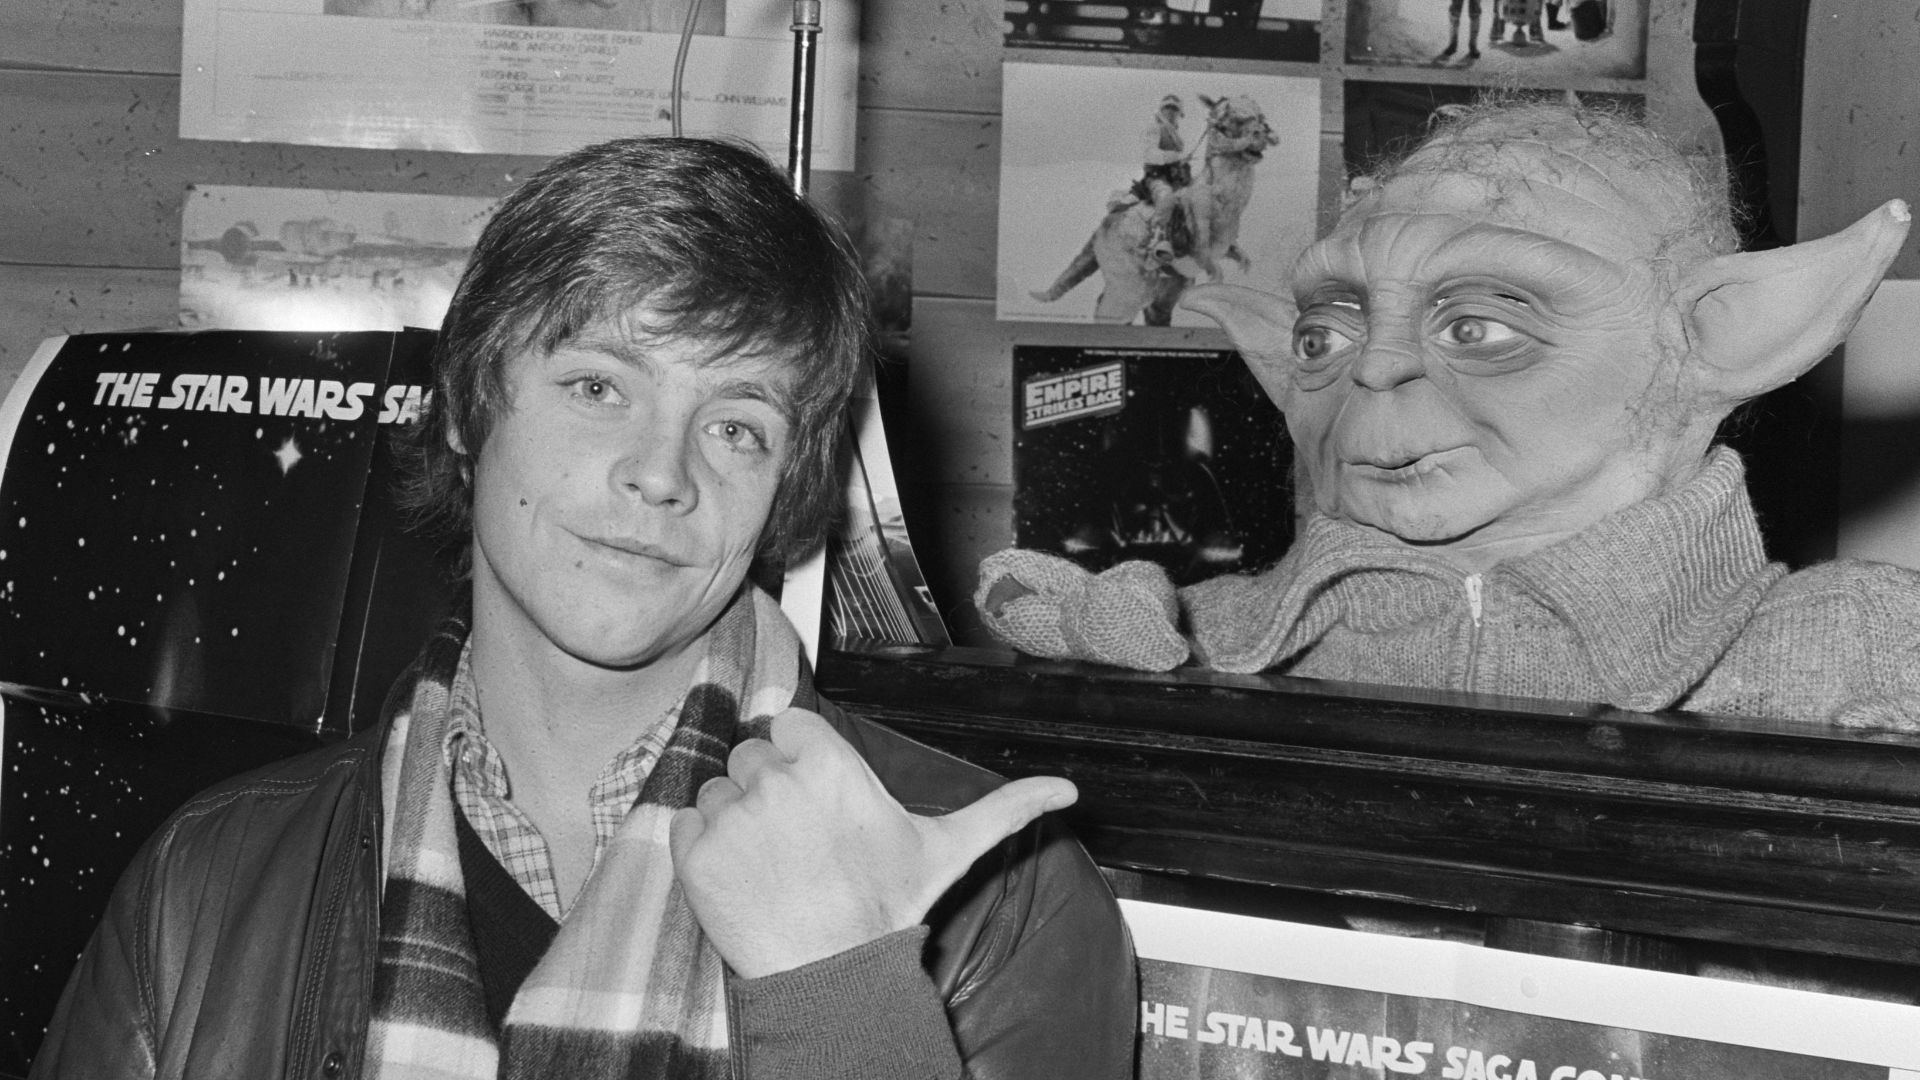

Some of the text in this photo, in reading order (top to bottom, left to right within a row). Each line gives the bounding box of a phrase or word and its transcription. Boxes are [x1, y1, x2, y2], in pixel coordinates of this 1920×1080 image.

[93, 372, 161, 408] THE
[157, 374, 252, 414] STAR
[259, 377, 375, 421] WARS
[1026, 370, 1121, 408] EMPIRE
[1026, 388, 1123, 420] STRIKES BACK
[1141, 1000, 1538, 1080] HE STAR WARS SAGA
